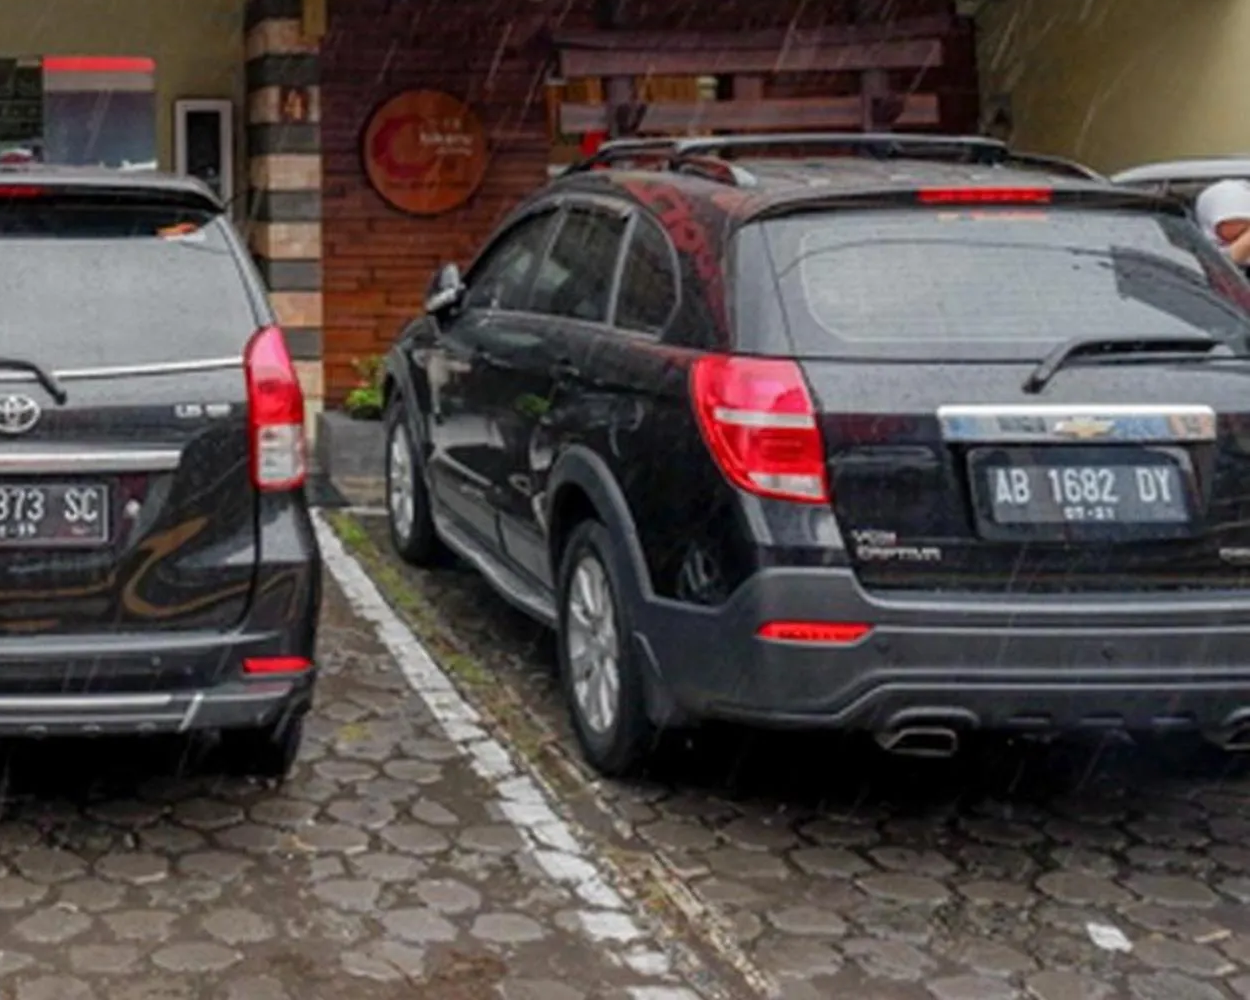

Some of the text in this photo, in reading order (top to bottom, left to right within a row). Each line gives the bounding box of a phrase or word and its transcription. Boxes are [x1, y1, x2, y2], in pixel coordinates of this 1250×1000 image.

[996, 467, 1171, 504] AB 1682 DY
[63, 487, 99, 522] SC
